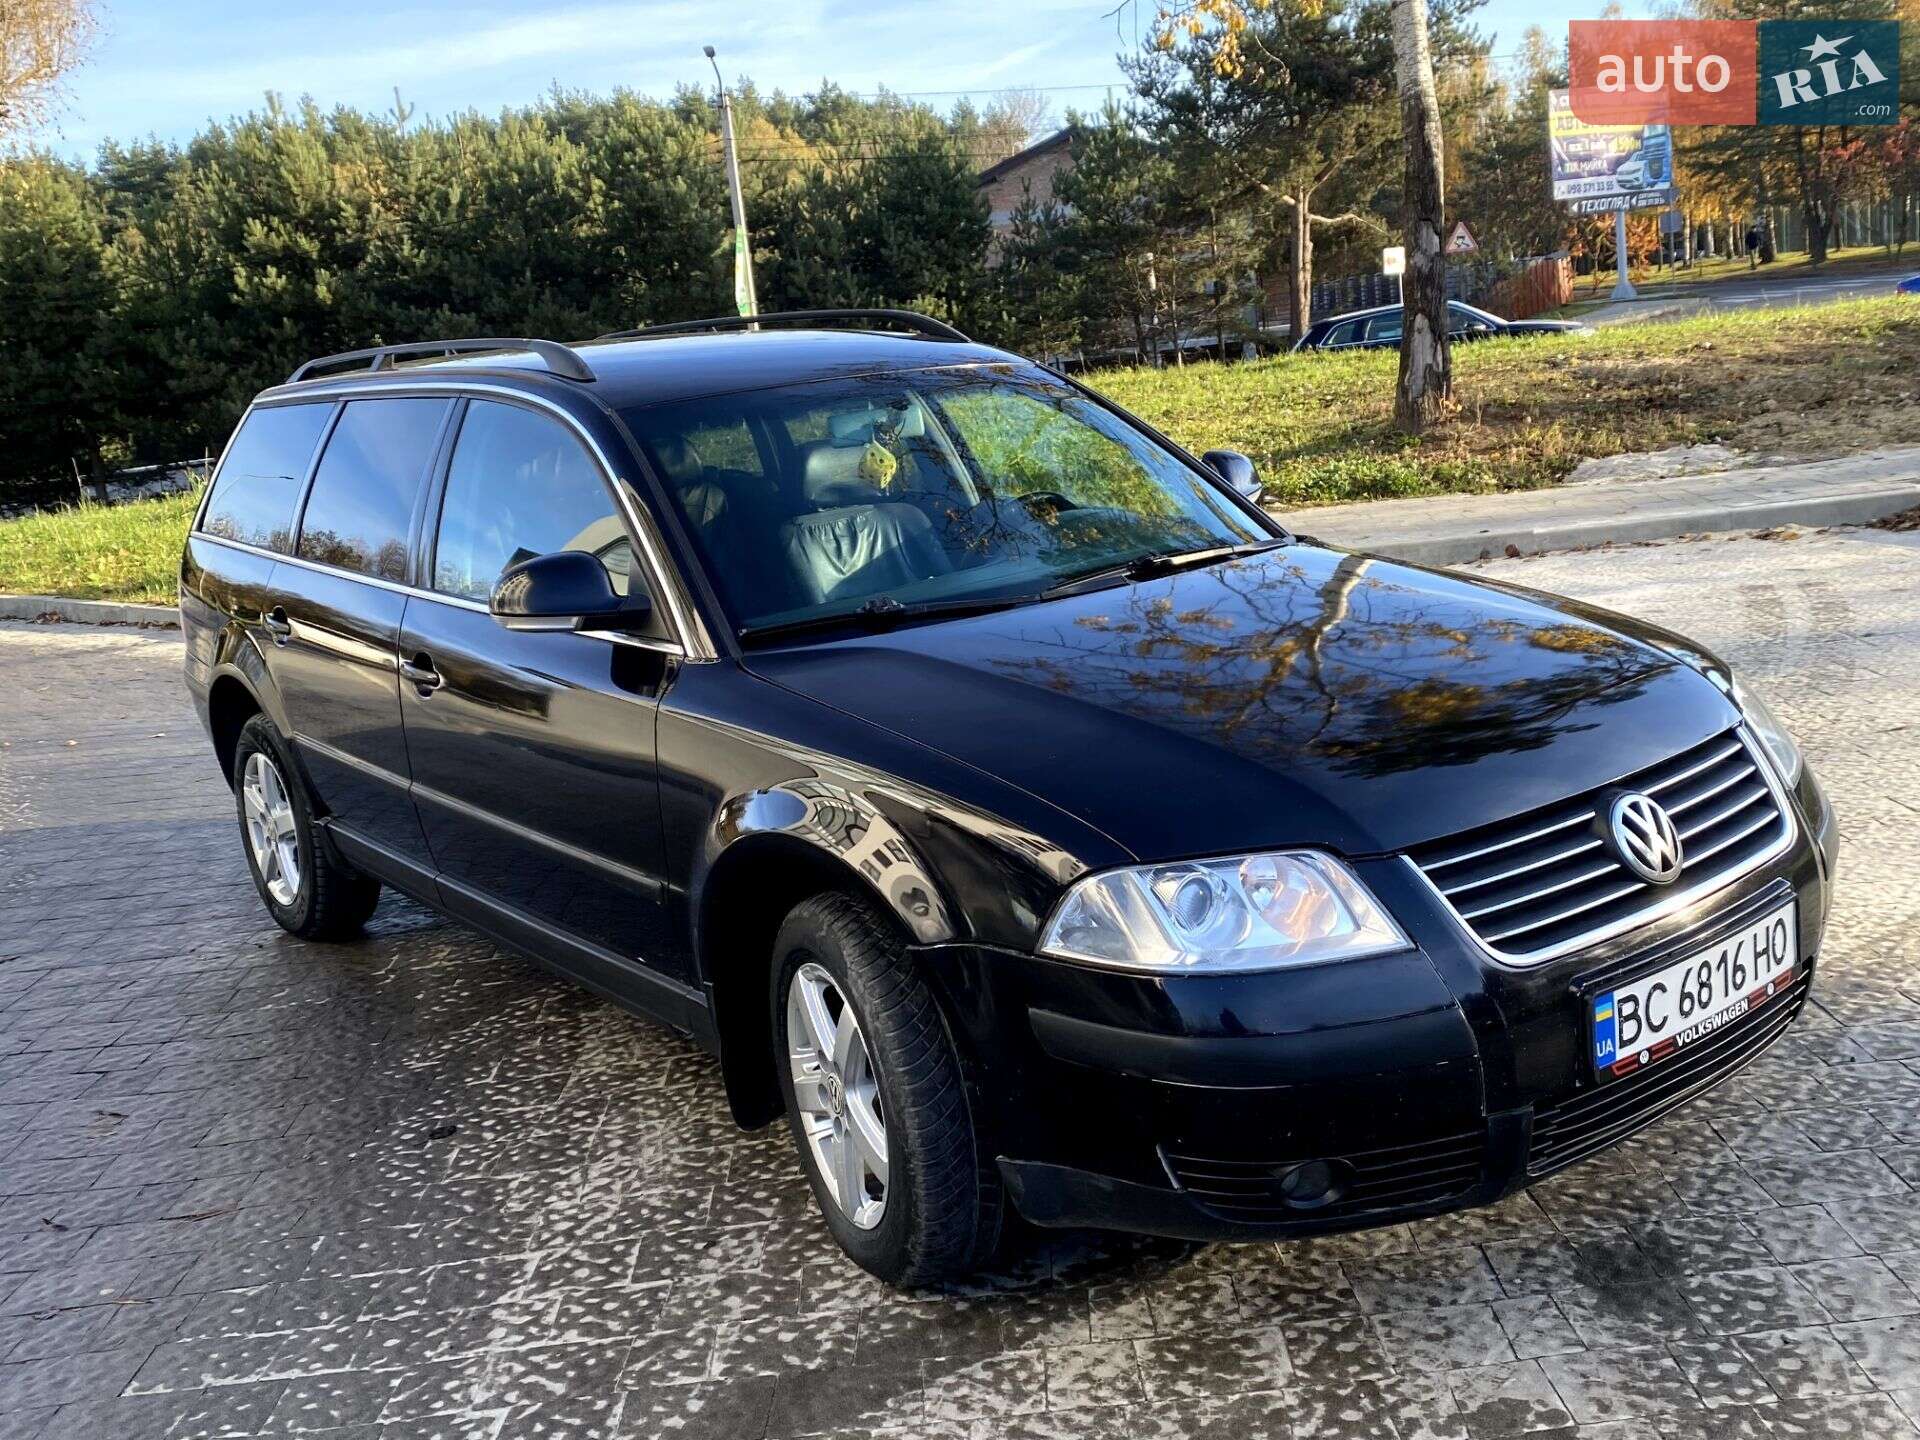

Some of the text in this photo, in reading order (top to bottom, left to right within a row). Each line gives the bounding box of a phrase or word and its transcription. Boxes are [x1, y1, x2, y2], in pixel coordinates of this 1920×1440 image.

[1580, 196, 1630, 212] ТЕХОГЛЯД
[1617, 917, 1787, 1049] BC 6816 HO
[1675, 998, 1749, 1047] VOLKSWAGEN
[1596, 1041, 1614, 1057] UA
